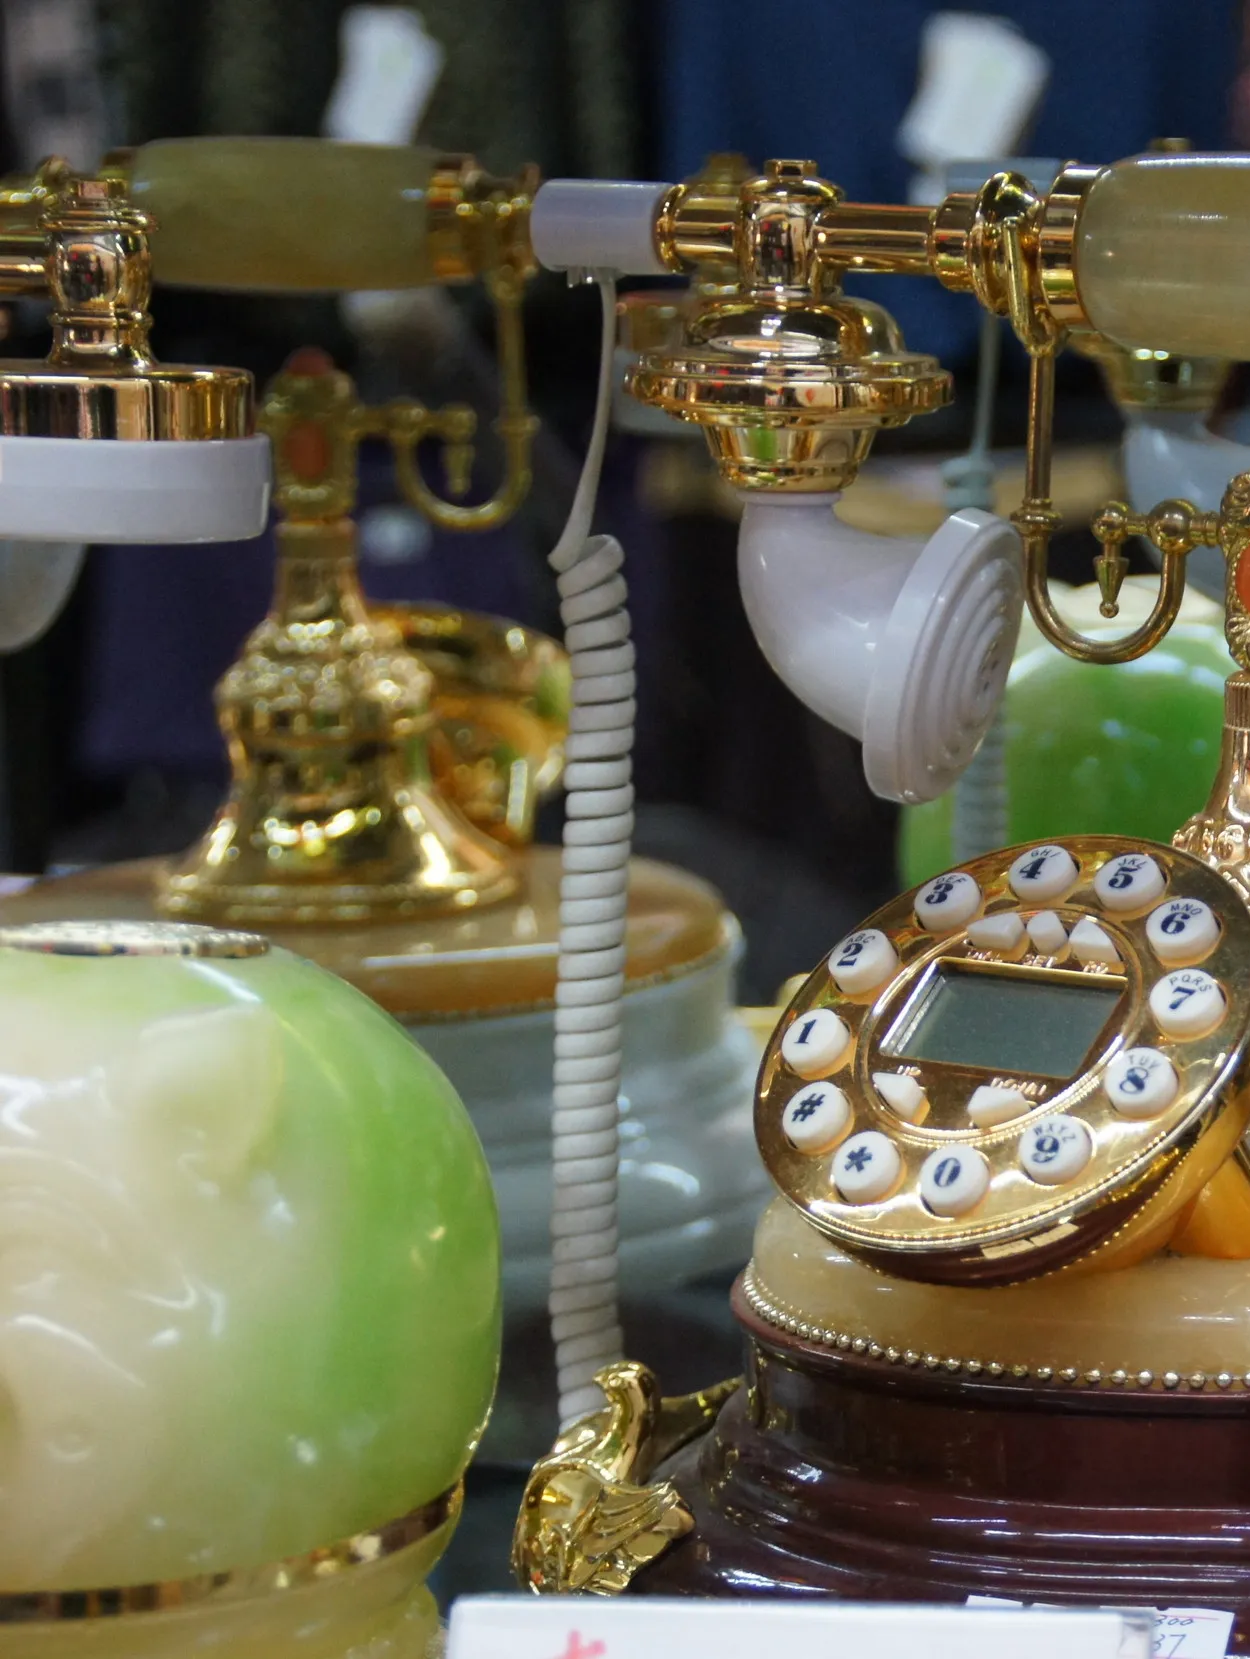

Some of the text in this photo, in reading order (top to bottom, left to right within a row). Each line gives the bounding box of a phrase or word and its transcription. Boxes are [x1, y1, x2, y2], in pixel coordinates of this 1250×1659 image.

[1019, 857, 1046, 880] 4
[1108, 866, 1138, 889] 5
[925, 883, 953, 904] 3
[1170, 903, 1203, 916] MNO
[1161, 912, 1191, 935] 6
[836, 943, 863, 967] 2
[1169, 974, 1213, 992] PQRS
[1169, 987, 1196, 1010] 7
[794, 1019, 818, 1044] 1
[1128, 1055, 1161, 1069] TUV
[1119, 1067, 1149, 1095] 8
[1033, 1122, 1076, 1143] WXYZ
[1032, 1135, 1060, 1163] 9
[933, 1157, 962, 1188] 0
